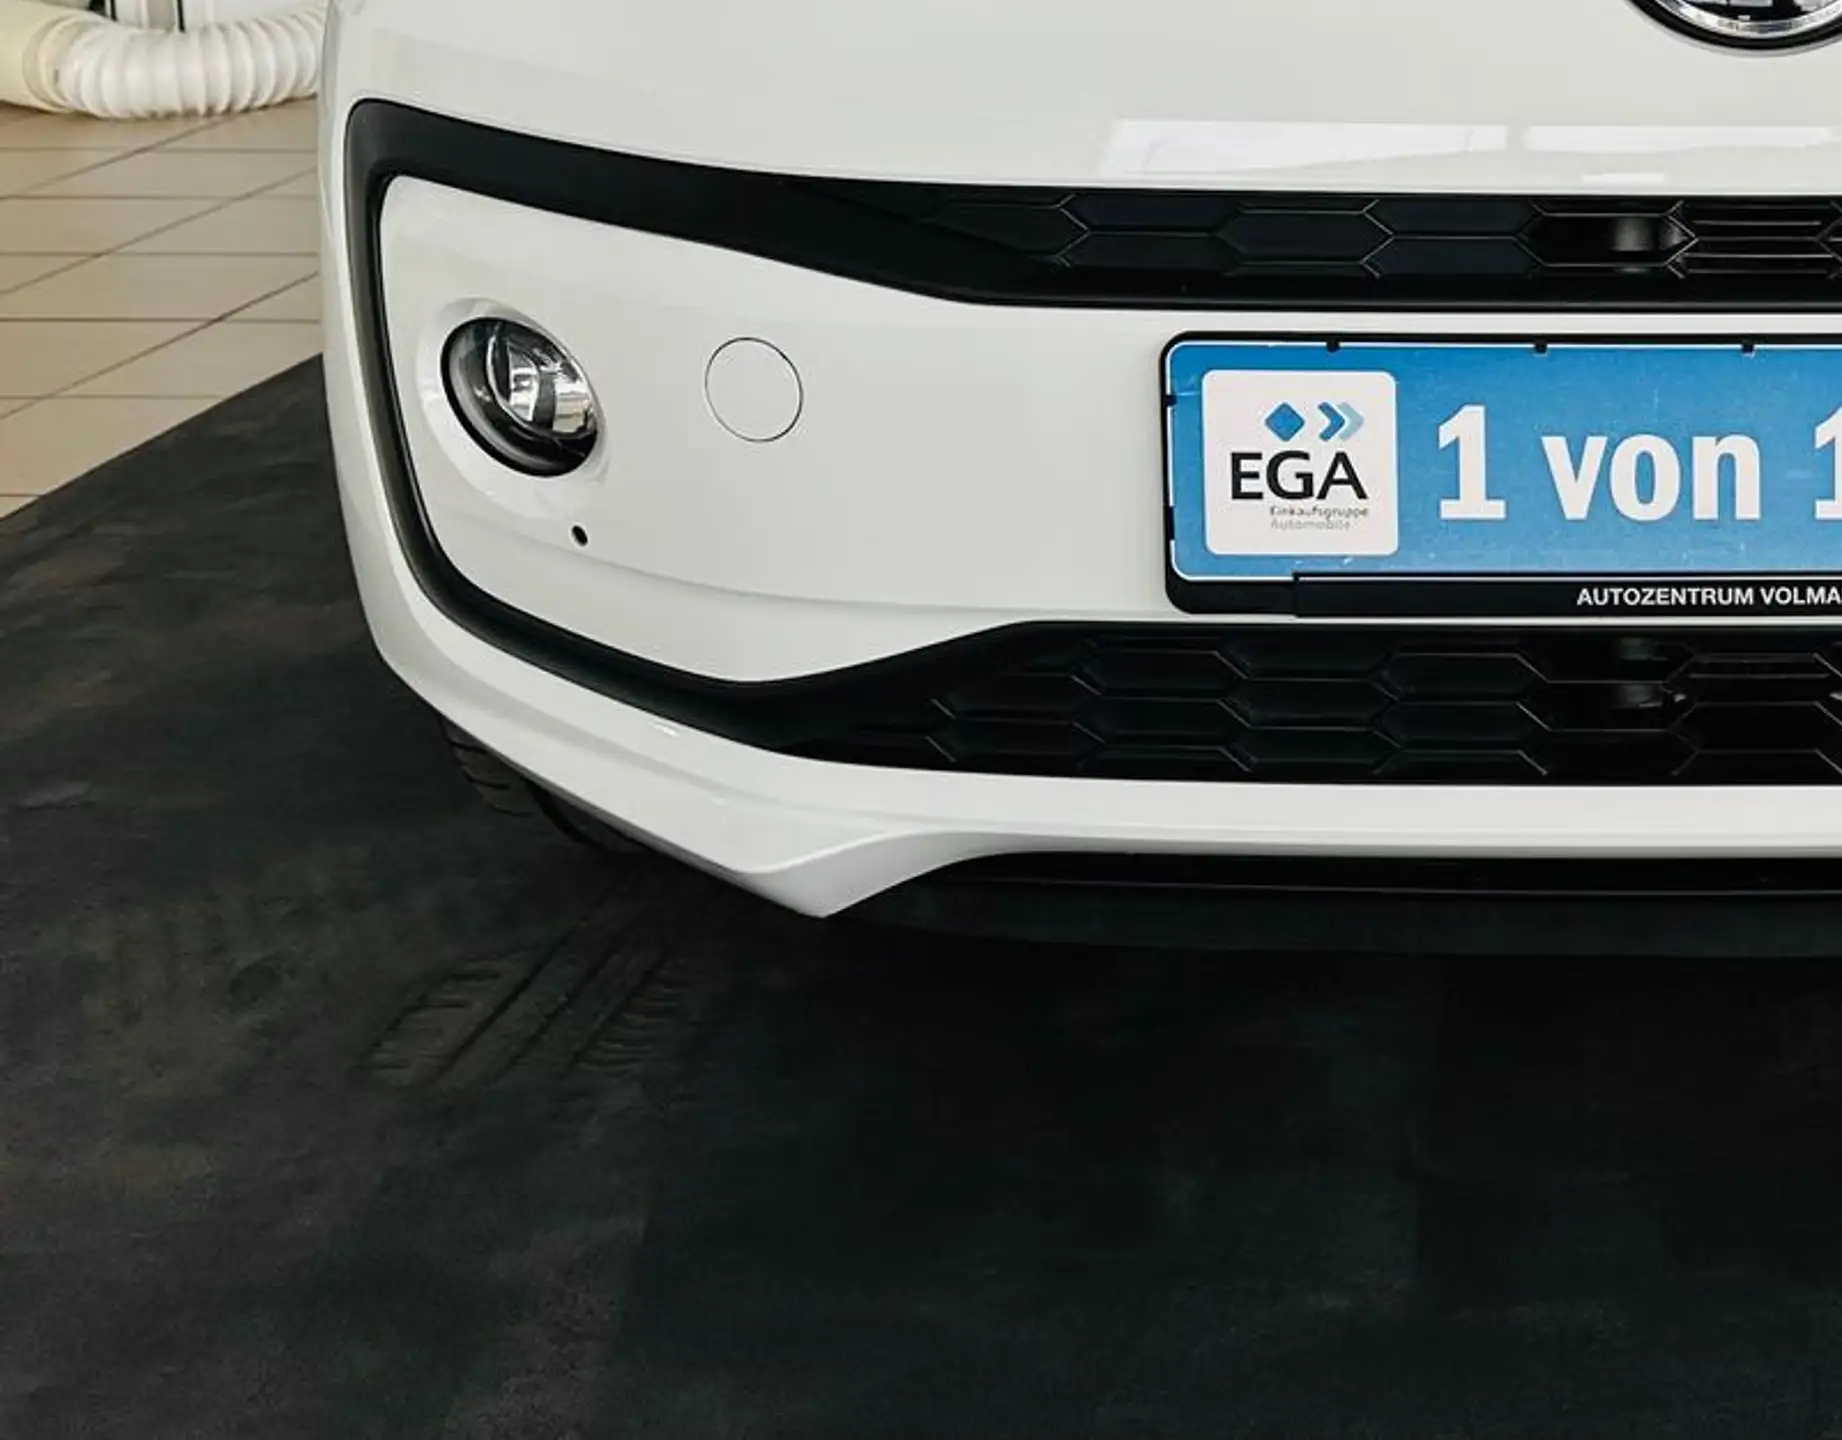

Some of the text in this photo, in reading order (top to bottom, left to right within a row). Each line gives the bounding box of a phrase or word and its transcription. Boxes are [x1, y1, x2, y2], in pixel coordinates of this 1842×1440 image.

[1231, 450, 1369, 501] EGA
[1438, 404, 1508, 520] 1
[1541, 433, 1761, 522] von
[1576, 587, 1754, 606] AUTOZENTRUM
